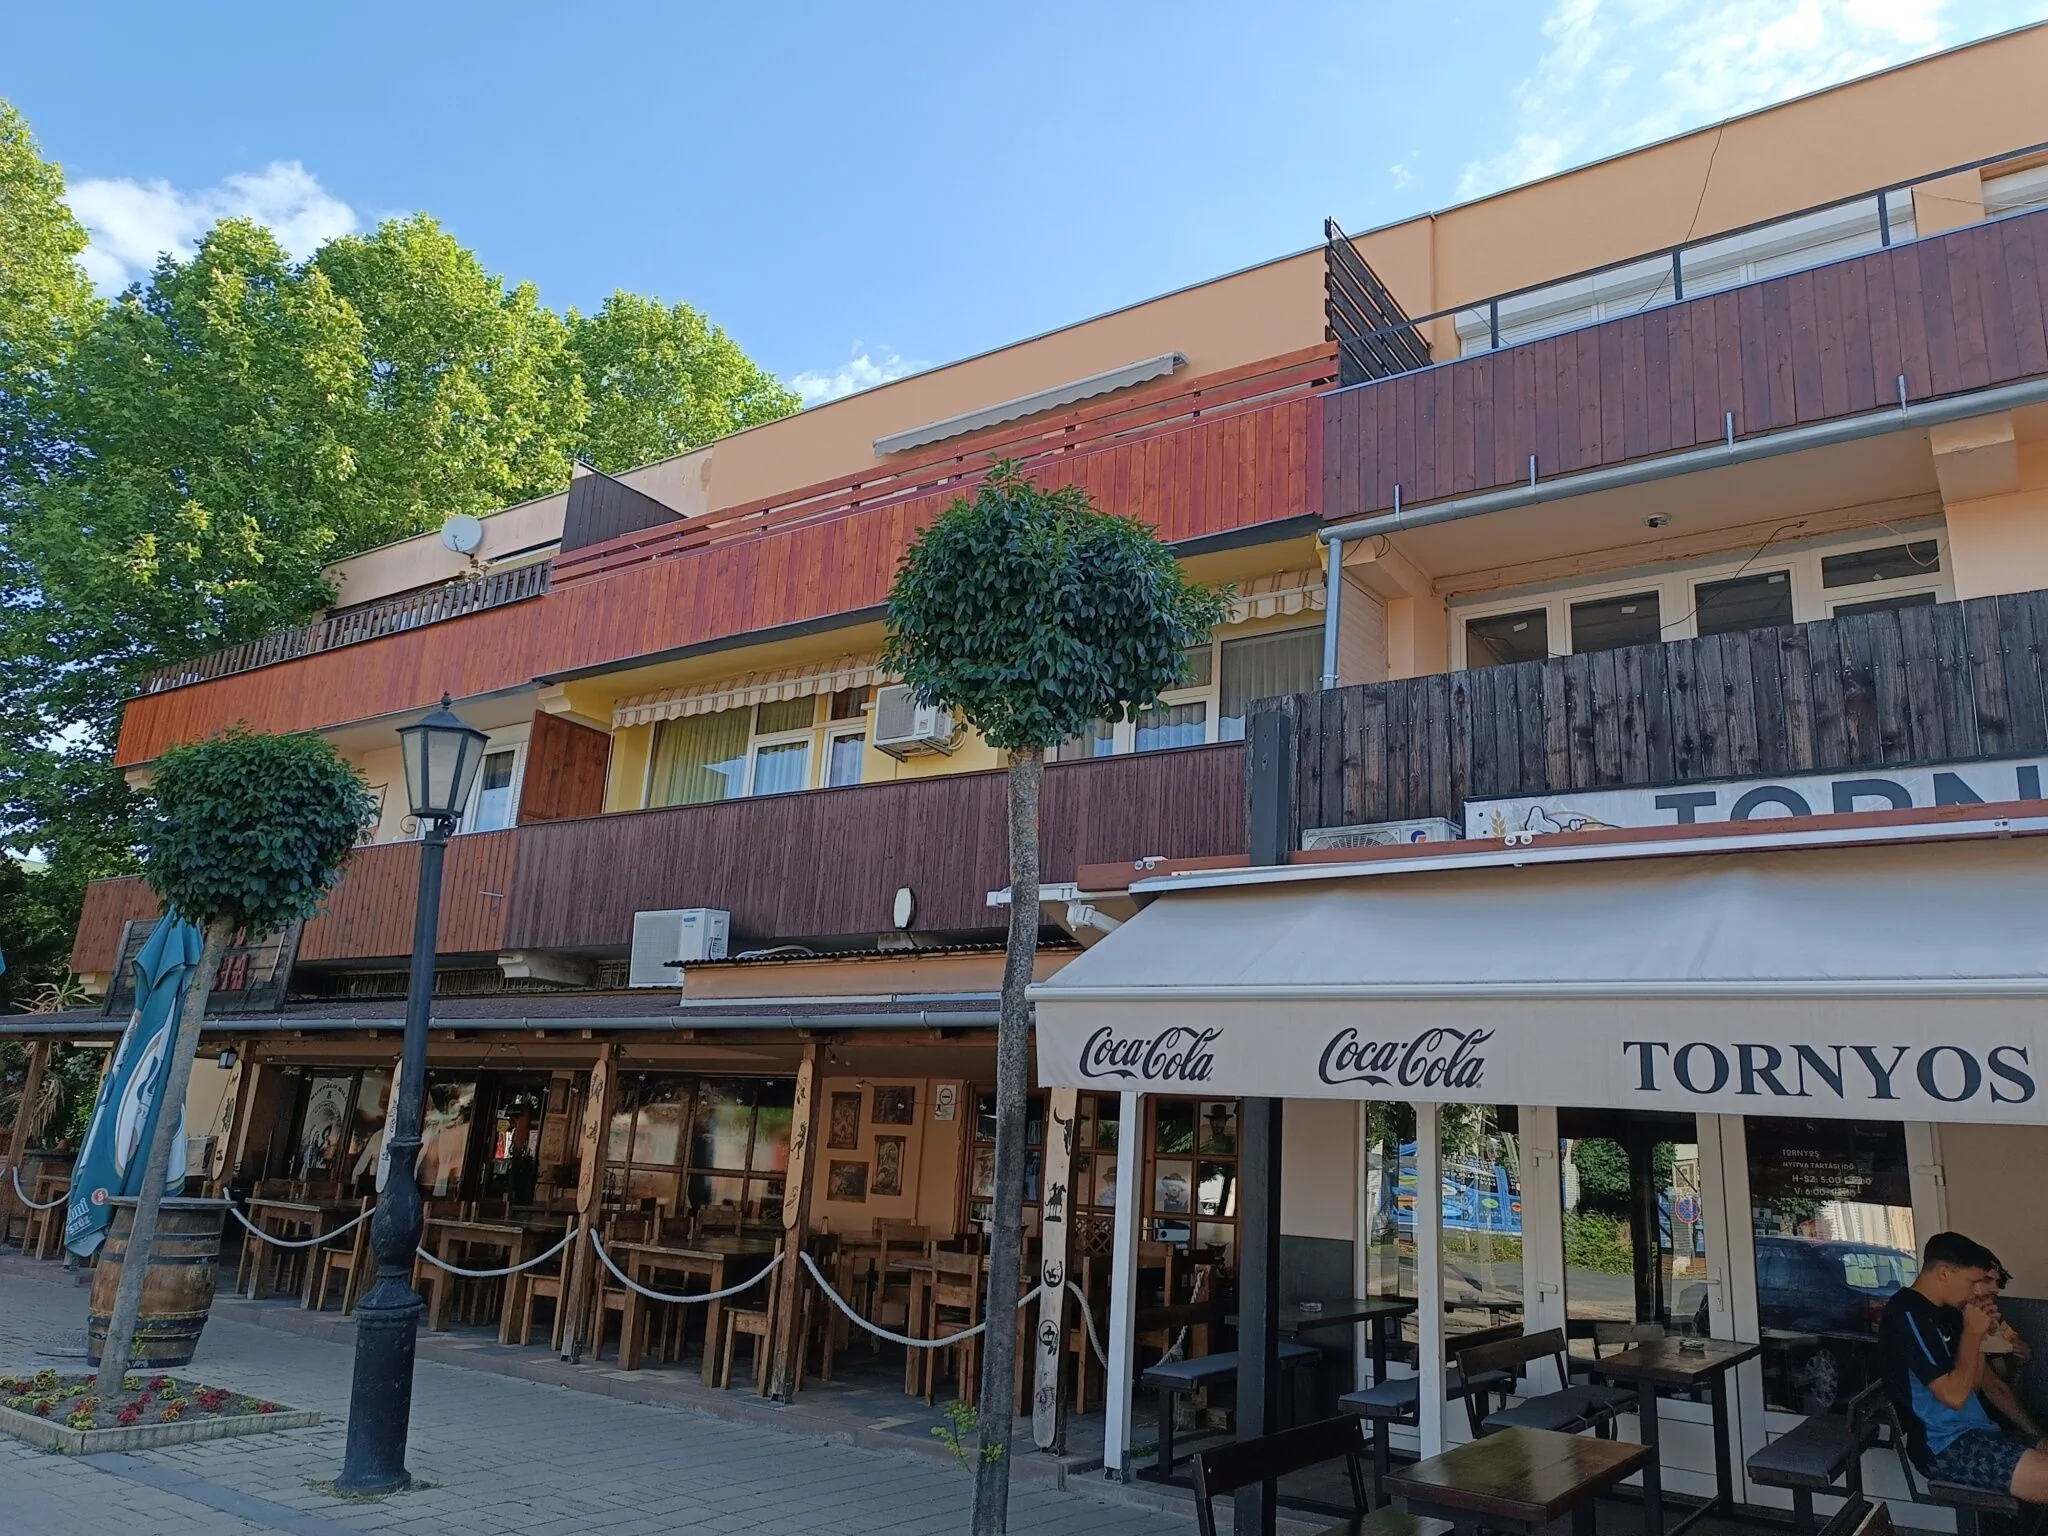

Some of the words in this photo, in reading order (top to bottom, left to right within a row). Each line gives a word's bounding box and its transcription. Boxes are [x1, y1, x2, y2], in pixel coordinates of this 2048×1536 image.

[1080, 1026, 1224, 1082] Coca-Cola
[1318, 1027, 1495, 1088] Coca-Cola
[1623, 1041, 2036, 1104] TORNYOS
[1782, 1149, 1820, 1158] TORNYOS
[1782, 1161, 1809, 1169] NYITVA
